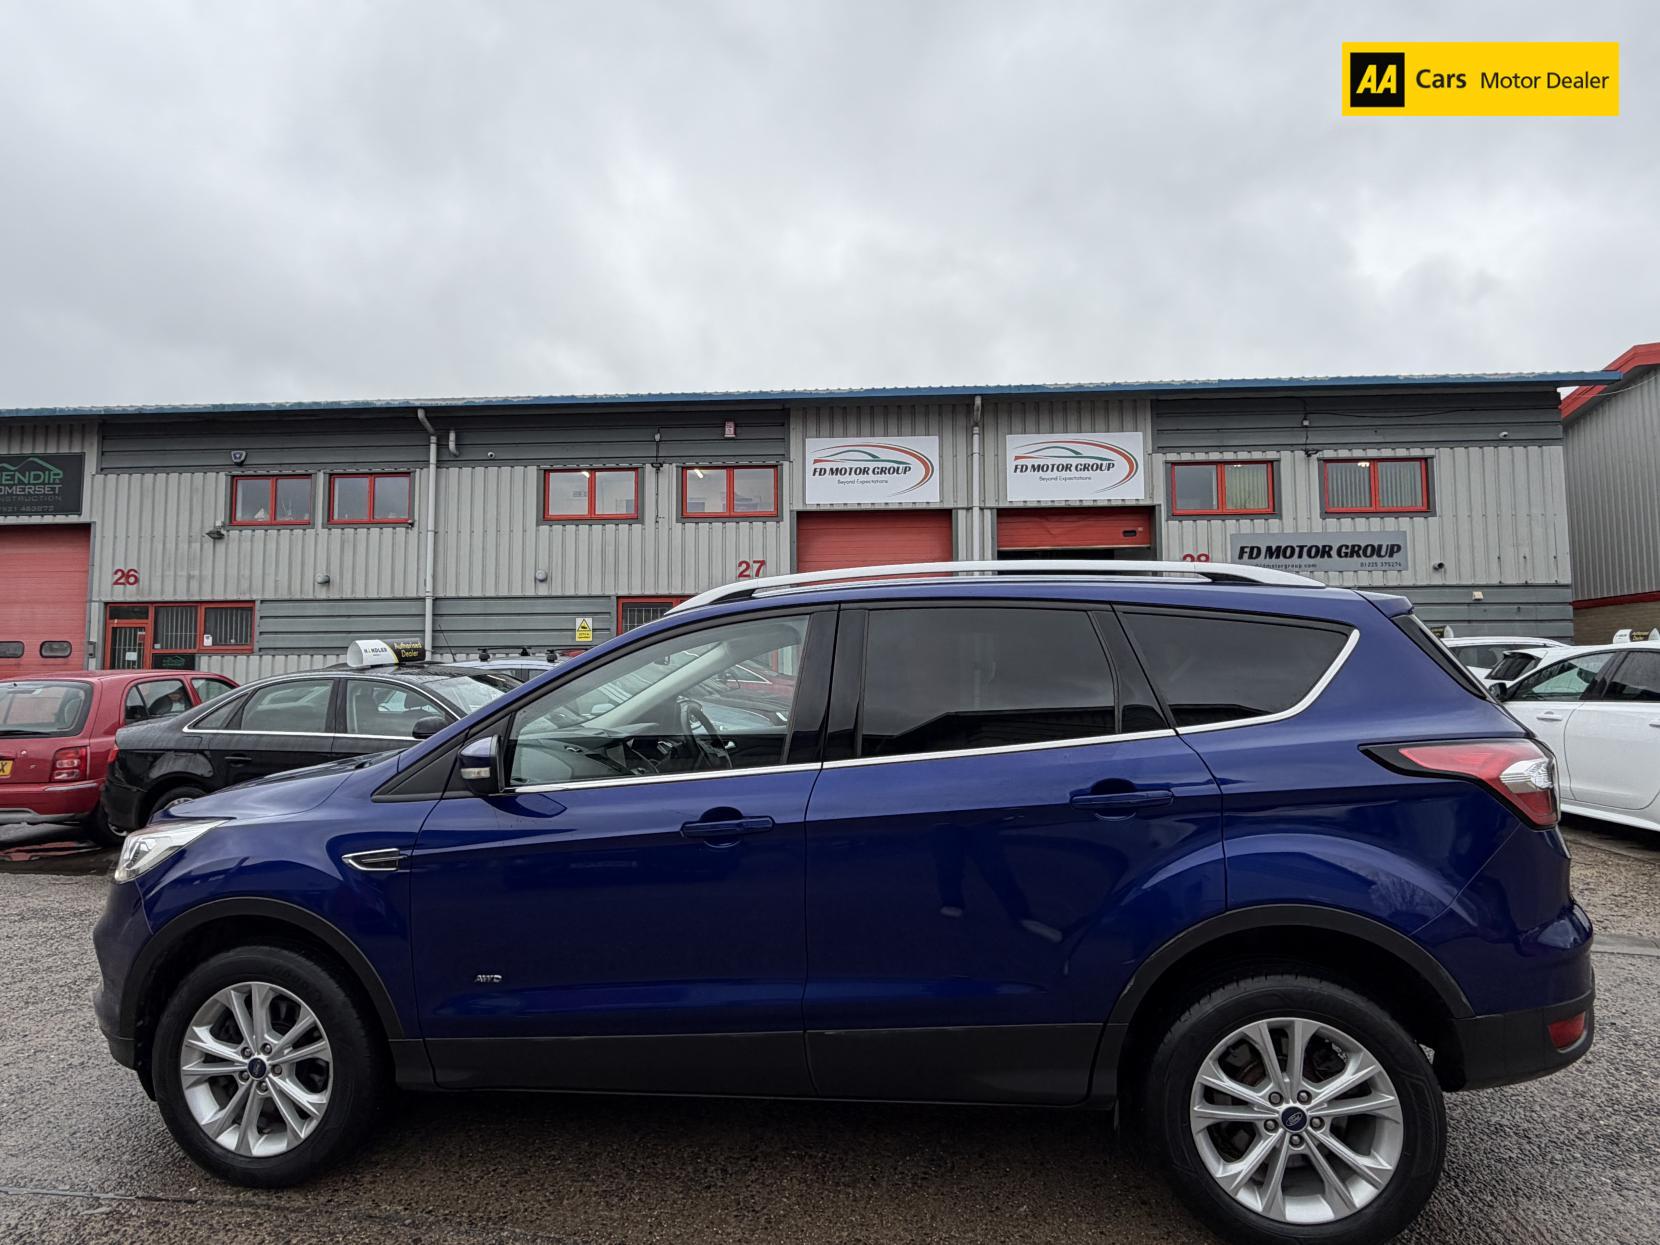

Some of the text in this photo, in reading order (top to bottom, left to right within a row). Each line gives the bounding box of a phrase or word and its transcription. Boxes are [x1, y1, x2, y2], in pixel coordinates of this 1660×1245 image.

[812, 465, 912, 477] FD MOTOR GROUP
[1013, 462, 1115, 474] FD MOTOR GROUP
[0, 471, 64, 484] ENDIP
[0, 485, 63, 495] OMERSET
[1238, 543, 1402, 560] FD MOTOR GROUP
[737, 560, 766, 578] 27
[112, 568, 140, 586] 26
